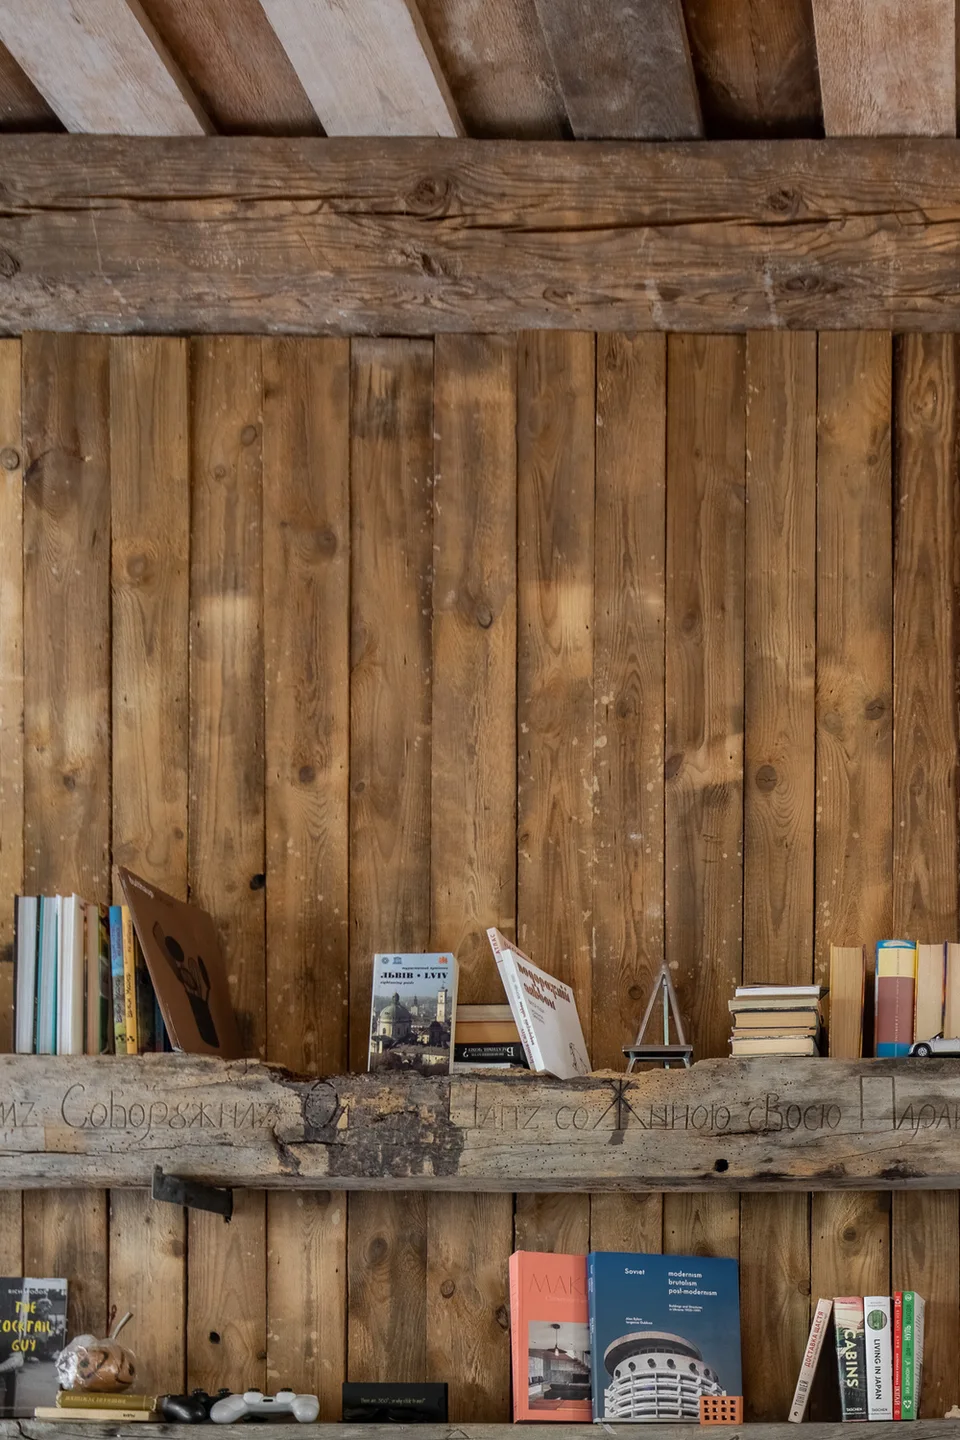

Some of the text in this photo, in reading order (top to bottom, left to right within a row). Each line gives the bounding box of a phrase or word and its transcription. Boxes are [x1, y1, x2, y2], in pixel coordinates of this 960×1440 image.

[624, 1267, 646, 1276] Soviet
[668, 1270, 703, 1278] modernism
[668, 1279, 698, 1287] brutalism
[668, 1287, 718, 1296] post-modernism
[15, 1301, 37, 1314] THE
[804, 1334, 818, 1368] ДОСТАВКА
[816, 1311, 824, 1334] ЩАСТЯ
[11, 1339, 37, 1352] GUY
[873, 1339, 882, 1364] LIVING
[844, 1329, 859, 1388] CABINS
[875, 1365, 882, 1374] IN
